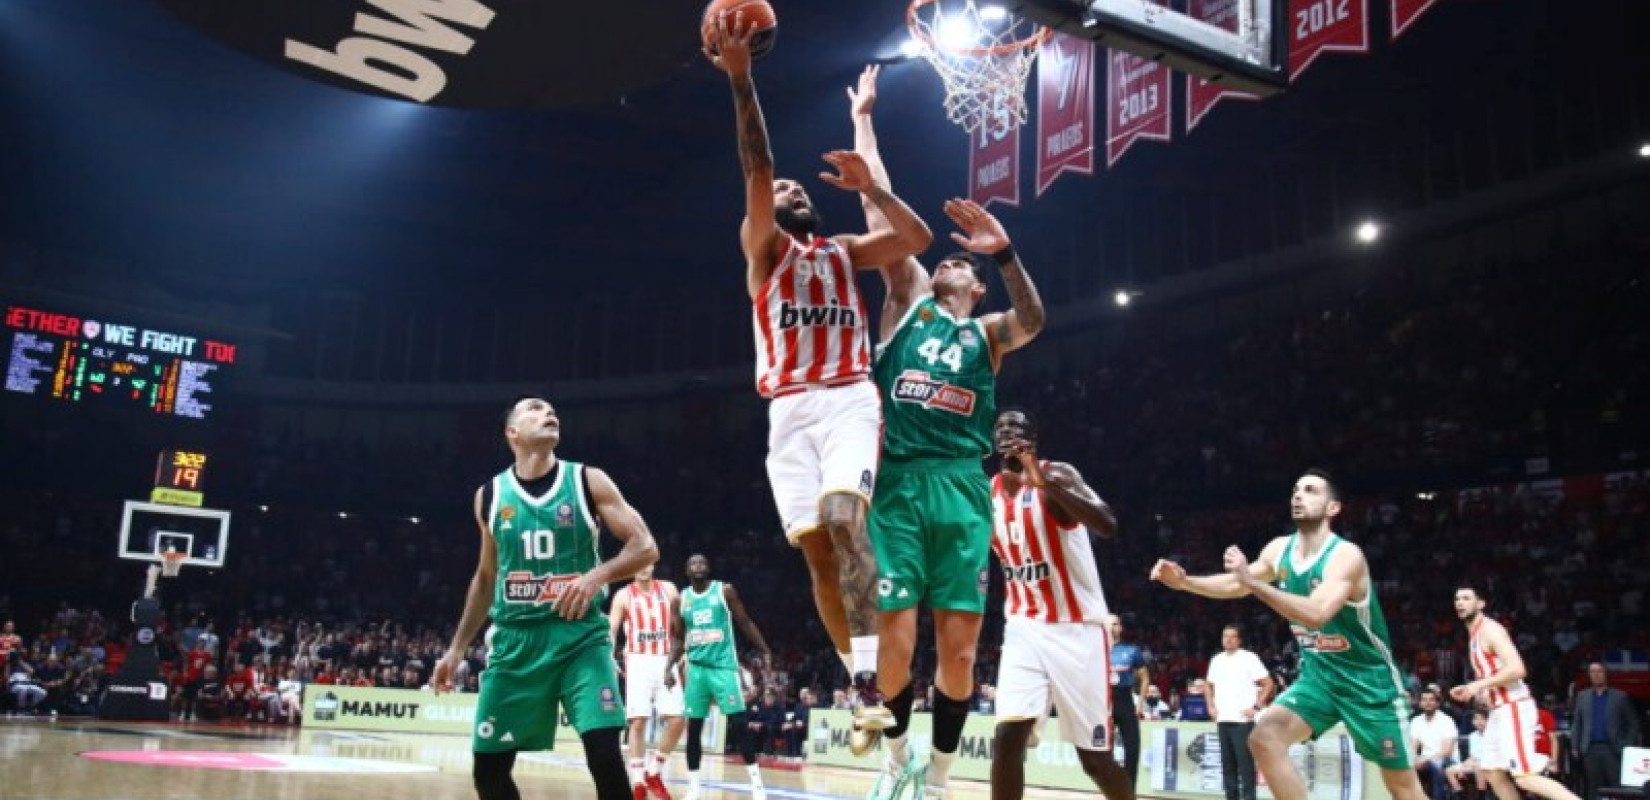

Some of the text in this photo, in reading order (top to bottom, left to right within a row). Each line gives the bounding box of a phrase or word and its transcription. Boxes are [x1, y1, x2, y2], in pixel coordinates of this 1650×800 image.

[1296, 0, 1349, 40] 2012
[1119, 83, 1158, 127] 2013
[779, 299, 856, 328] bwin
[104, 323, 136, 346] WE
[140, 330, 196, 356] FIGHT
[917, 337, 963, 373] 44
[173, 467, 199, 488] 19
[521, 529, 555, 560] 10
[692, 608, 713, 627] 22
[341, 699, 420, 719] MAMUT
